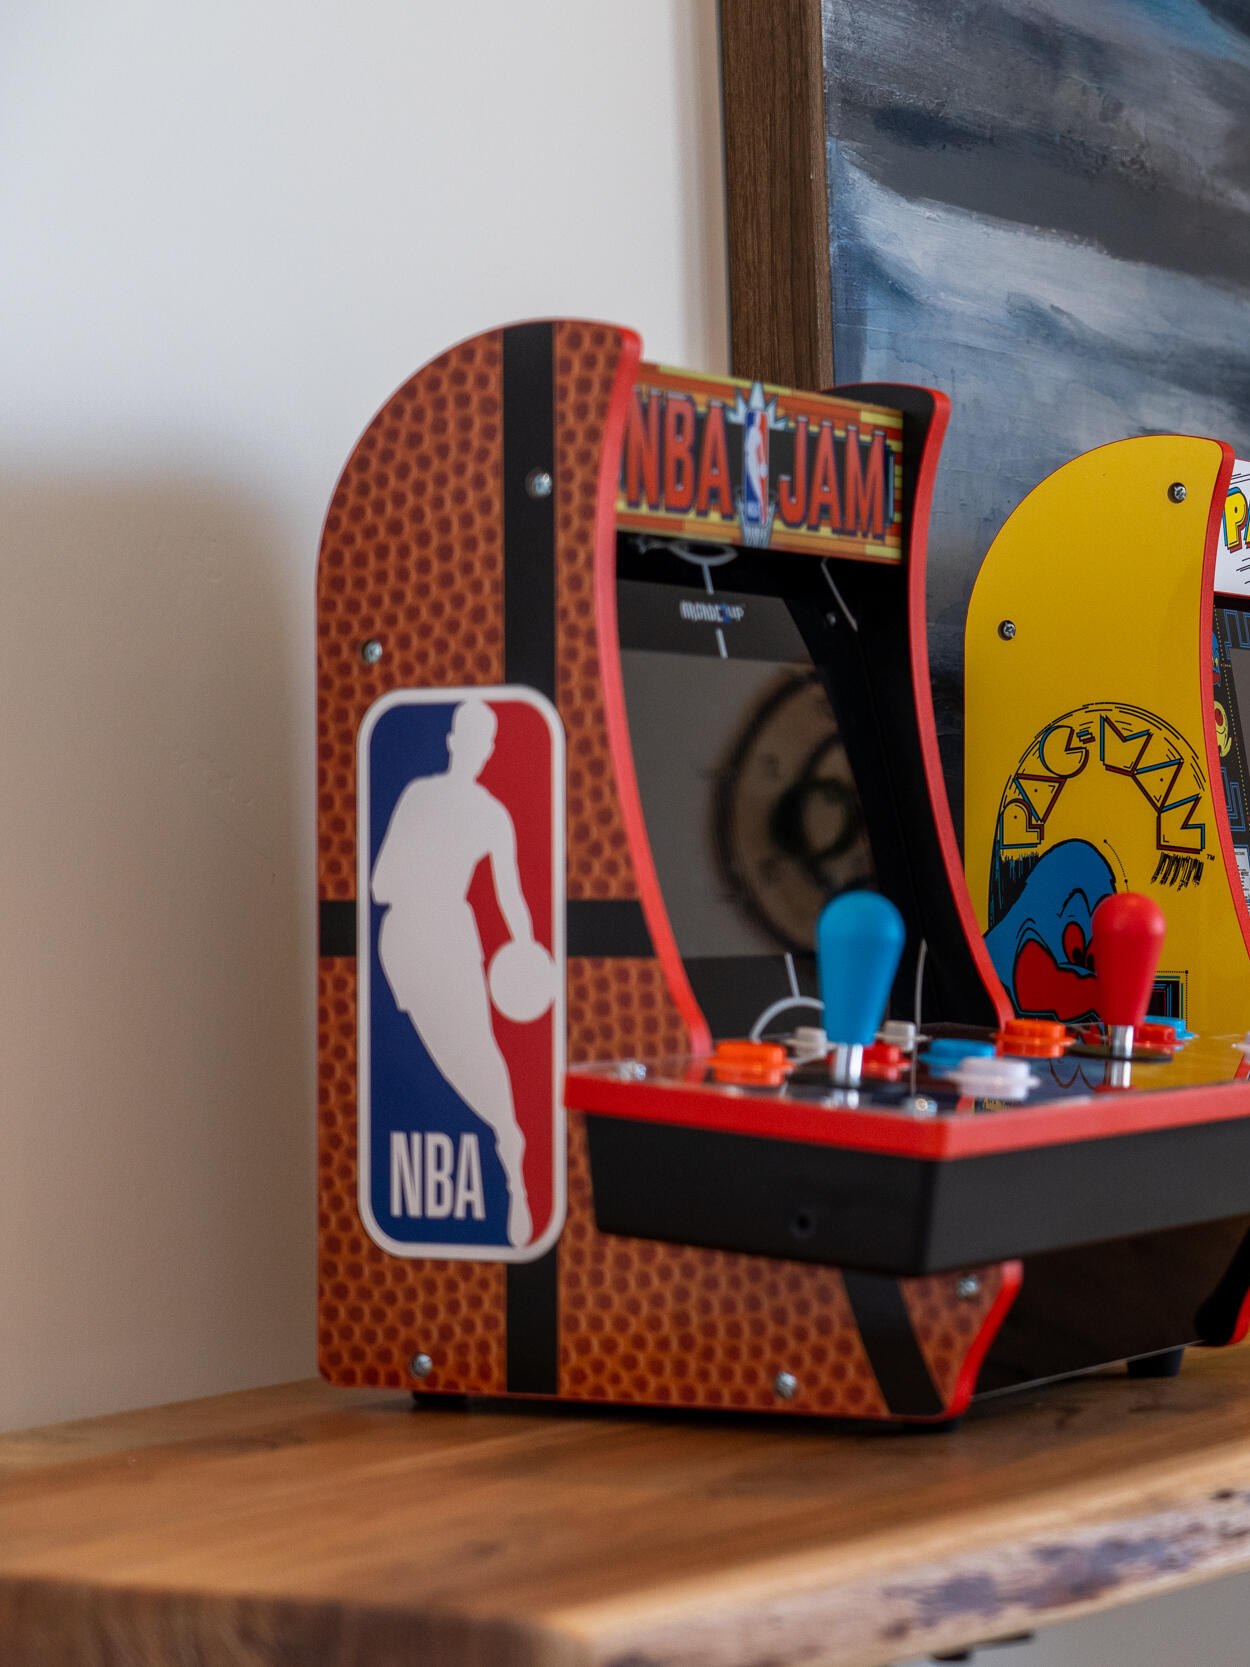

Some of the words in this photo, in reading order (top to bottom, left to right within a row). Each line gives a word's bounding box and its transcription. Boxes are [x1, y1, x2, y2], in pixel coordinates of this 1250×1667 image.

[625, 385, 735, 521] NBA
[778, 414, 886, 541] JAM
[1000, 714, 1206, 855] PAC-MAN
[389, 1131, 486, 1221] NBA
